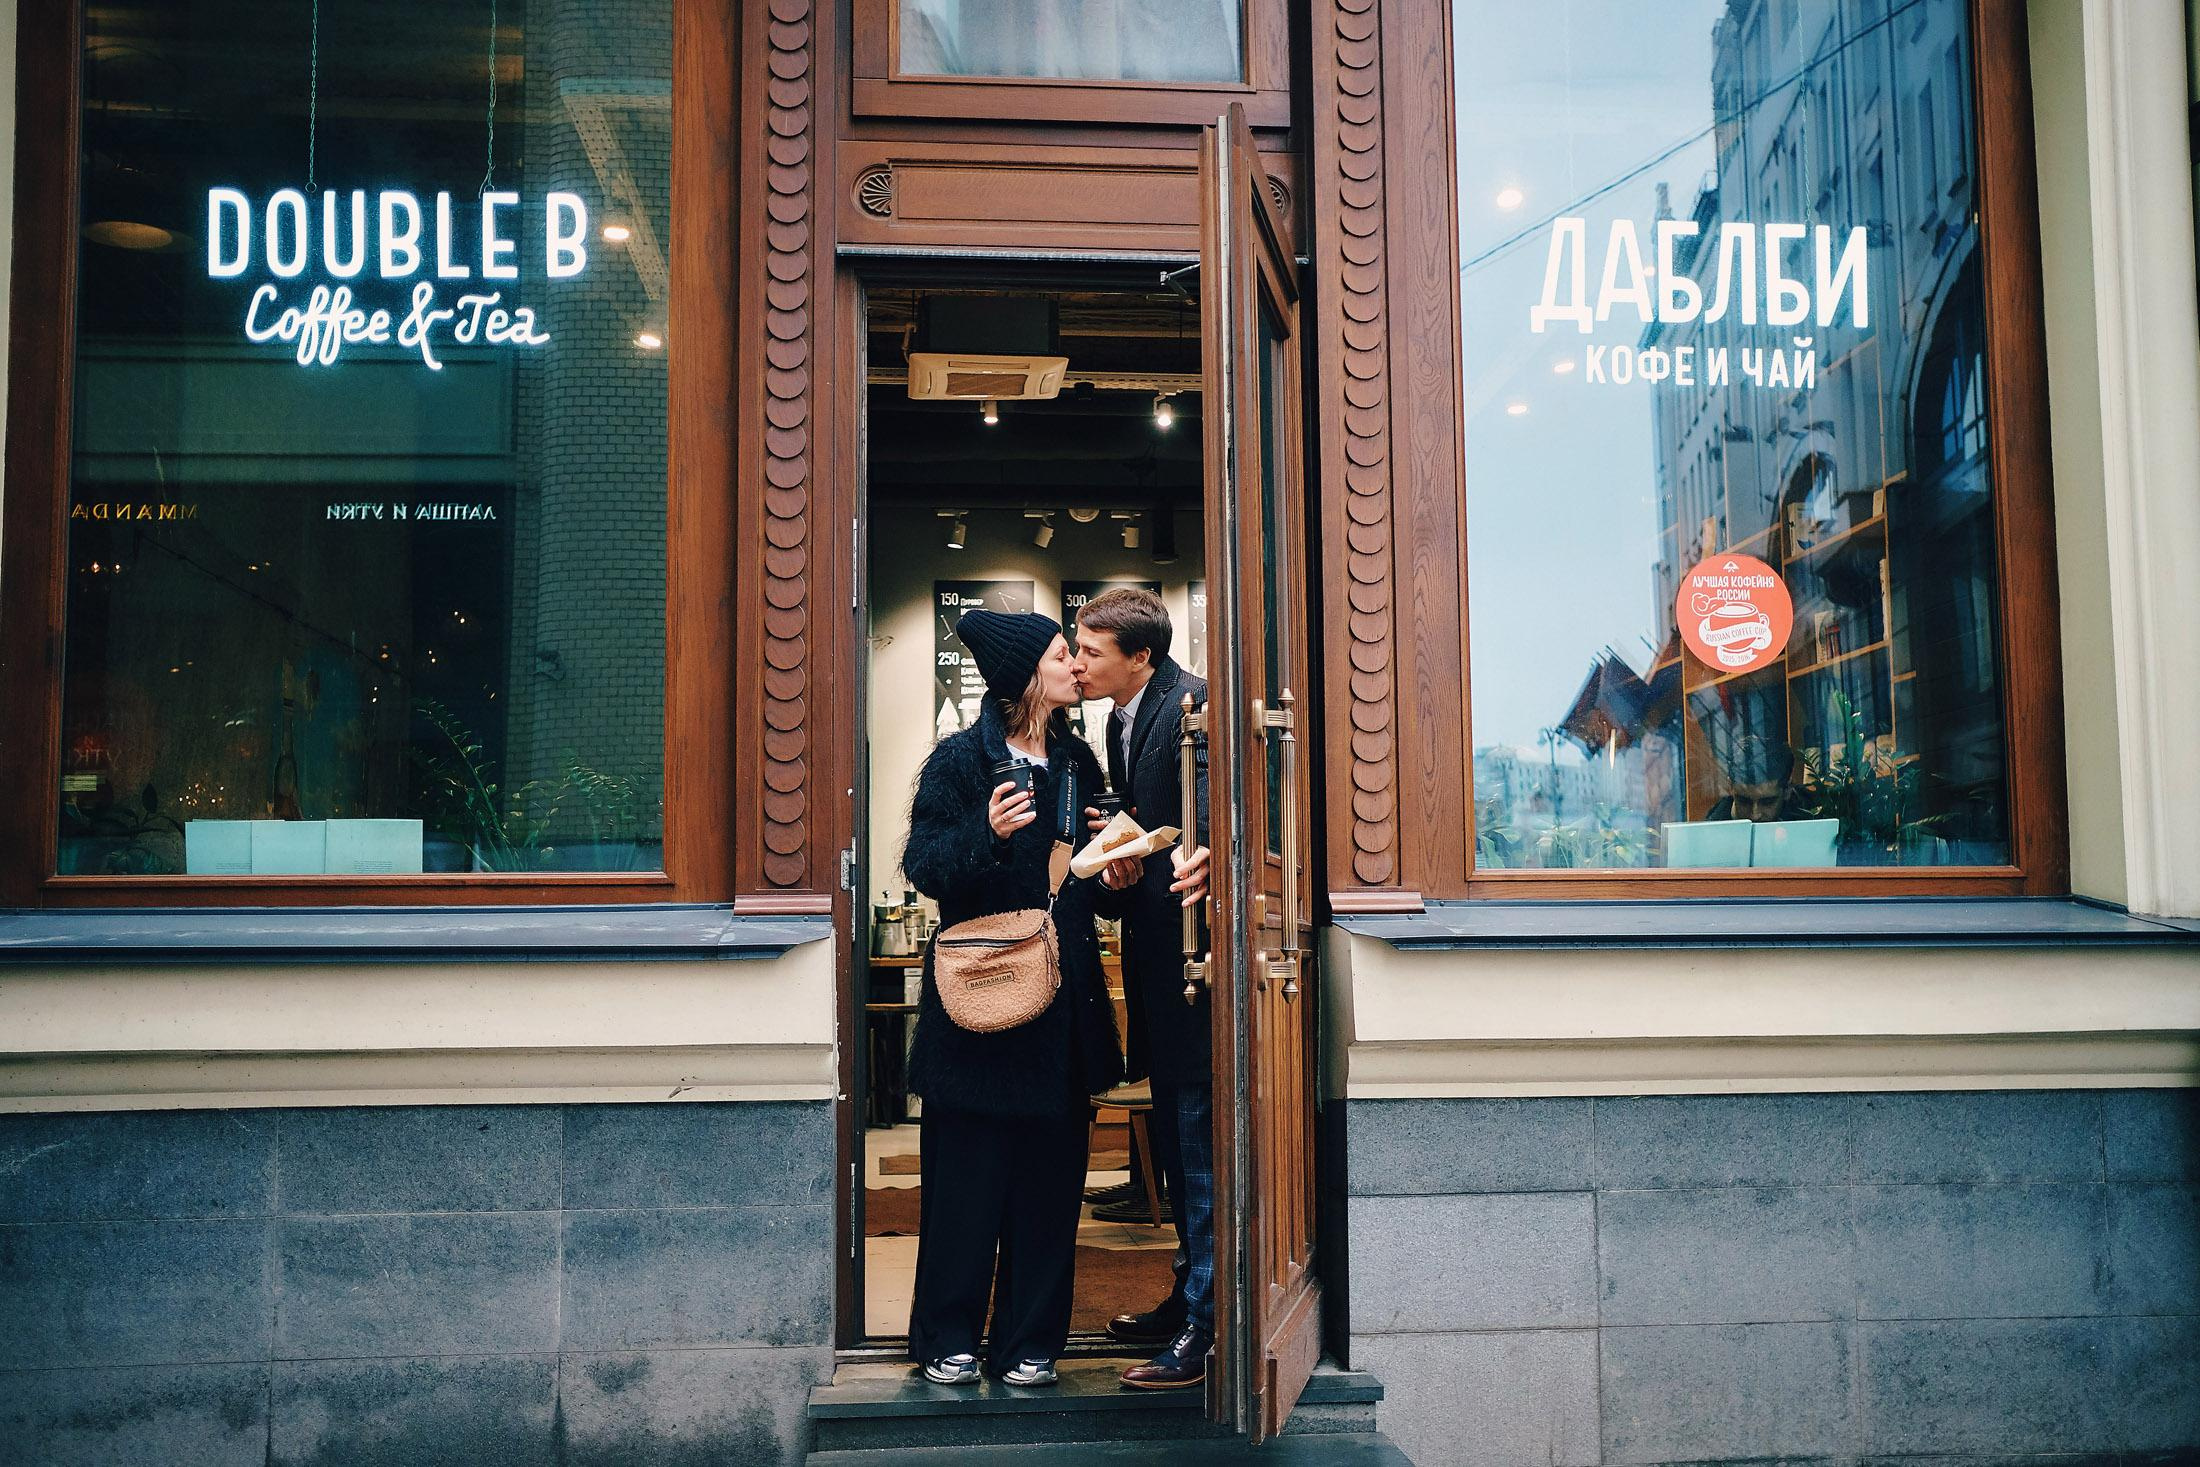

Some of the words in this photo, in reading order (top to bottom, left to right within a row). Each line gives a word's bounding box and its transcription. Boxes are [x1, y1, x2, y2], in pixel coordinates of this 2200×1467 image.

[208, 189, 519, 278] DOUBLE
[546, 191, 588, 278] B
[1530, 217, 1869, 334] ДАБЛБИ
[244, 283, 391, 366] Coffee
[397, 281, 454, 370] &
[454, 291, 551, 345] Tea
[1586, 344, 1695, 386] КОФЕ
[1707, 347, 1729, 387] И
[1742, 336, 1816, 390] ЧАЙ
[1692, 575, 1729, 588] ЛУЧШАЯ
[1731, 574, 1775, 588] КОФЕЙНЯ
[940, 593, 959, 606] 150
[1065, 594, 1087, 607] 300
[1191, 594, 1207, 608] 35
[1717, 589, 1751, 601] РОССИИ
[938, 652, 960, 666] 250
[970, 974, 1012, 988] BAGFASHION
